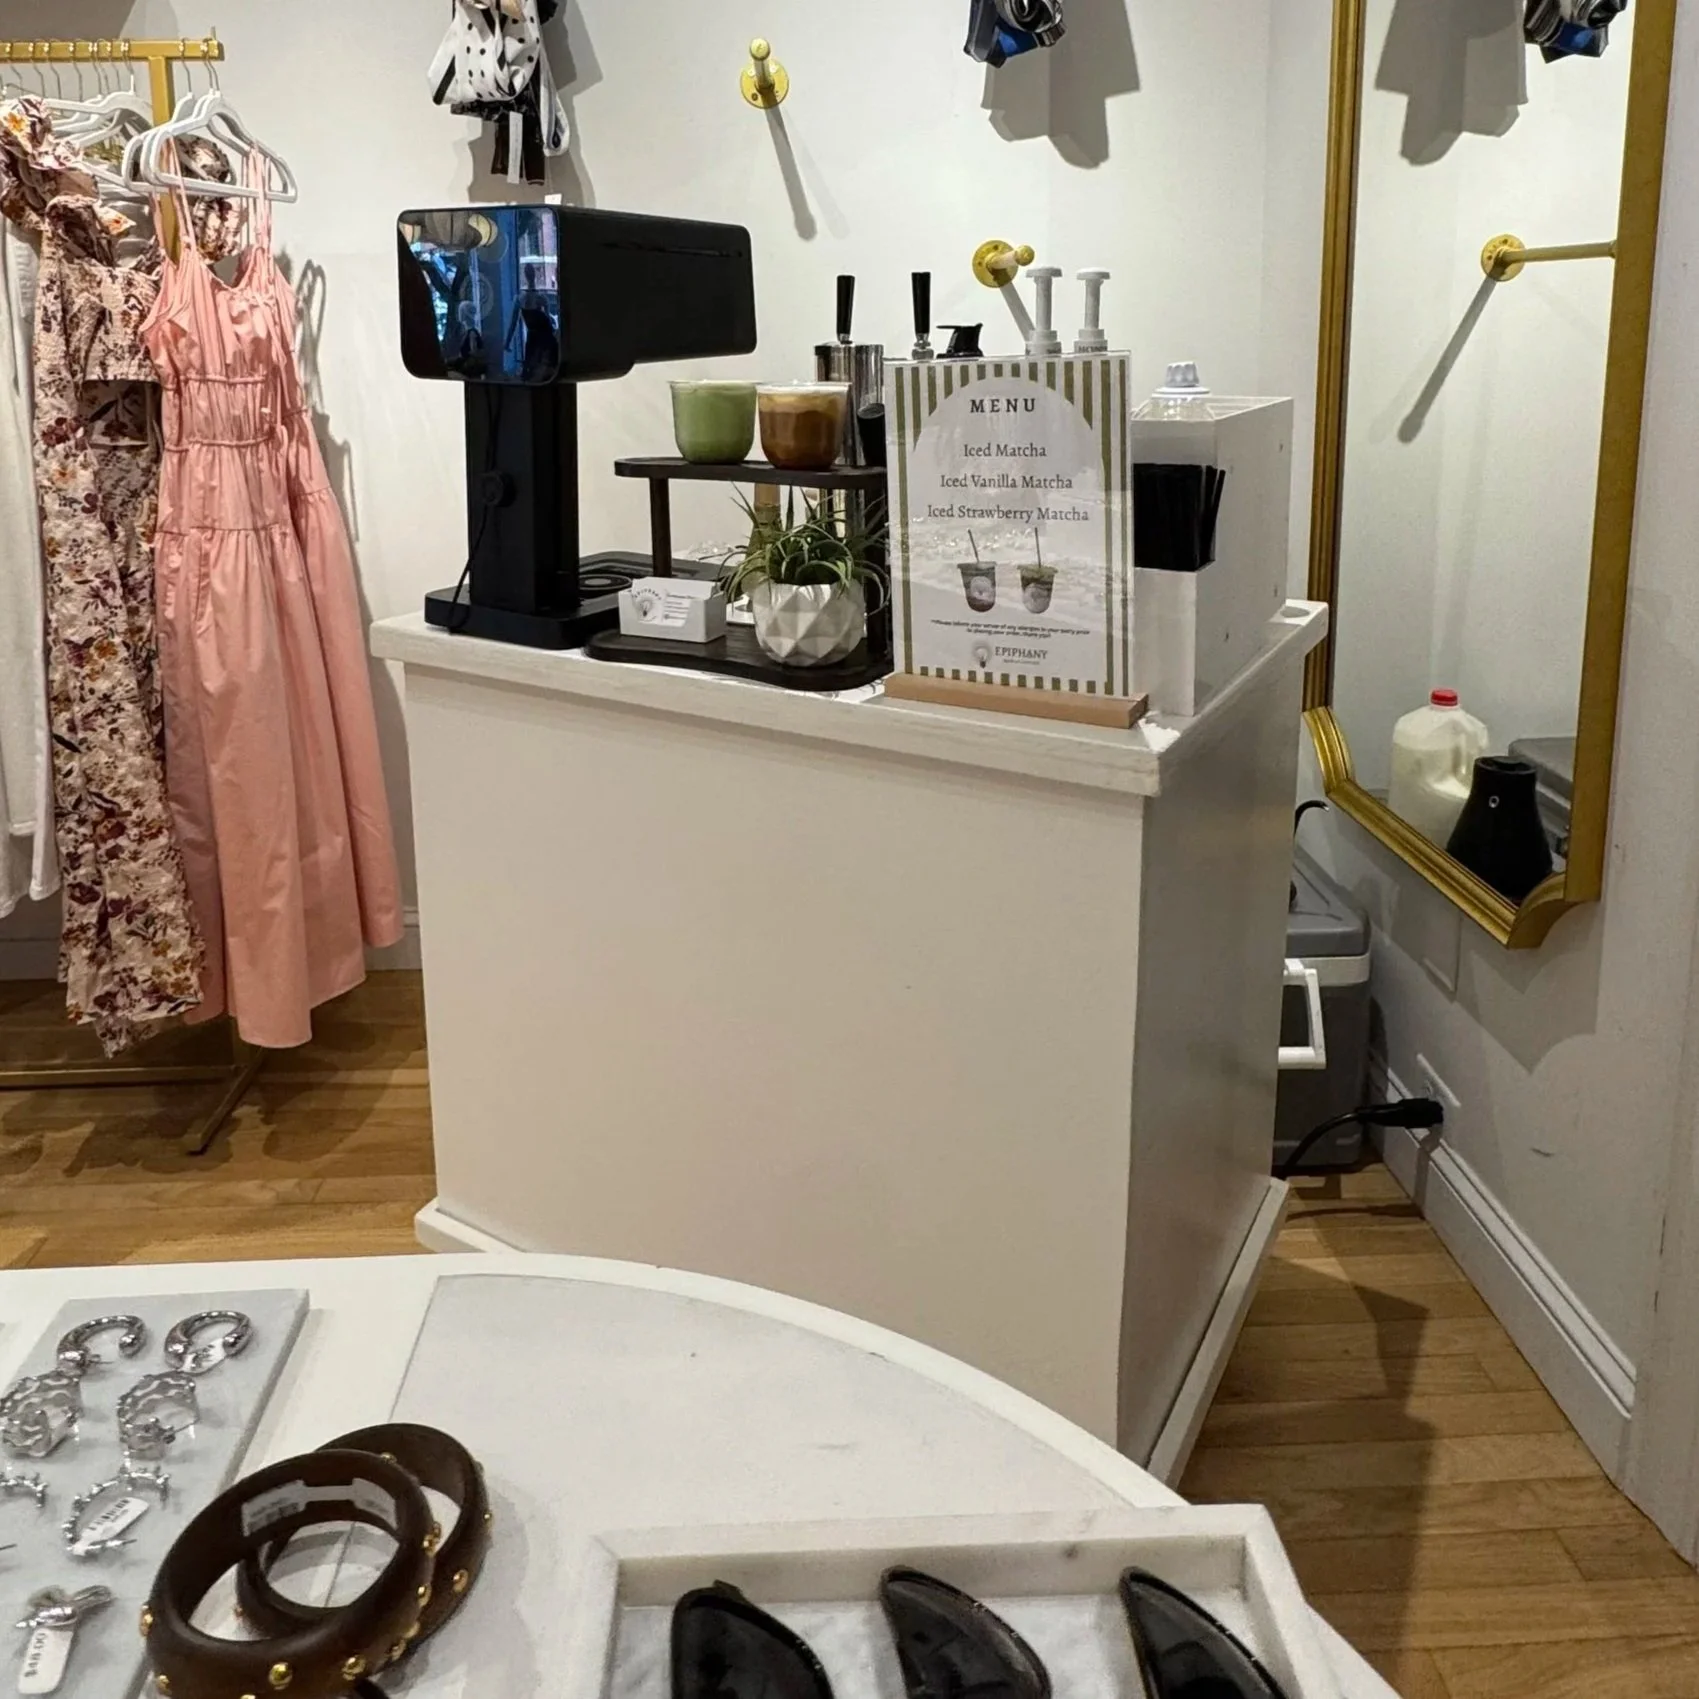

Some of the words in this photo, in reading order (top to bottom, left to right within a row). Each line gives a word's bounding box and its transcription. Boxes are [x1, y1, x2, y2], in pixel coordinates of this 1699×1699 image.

[970, 398, 1036, 413] MENU
[963, 443, 992, 457] Iced
[995, 442, 1047, 458] Matcha
[940, 474, 968, 488] Iced
[971, 474, 1017, 489] Vanilla
[1021, 474, 1073, 490] Matcha
[927, 504, 954, 518] Iced
[958, 504, 1033, 523] Strawberry
[1037, 506, 1089, 521] Matcha
[995, 646, 1048, 660] EPIPHANY
